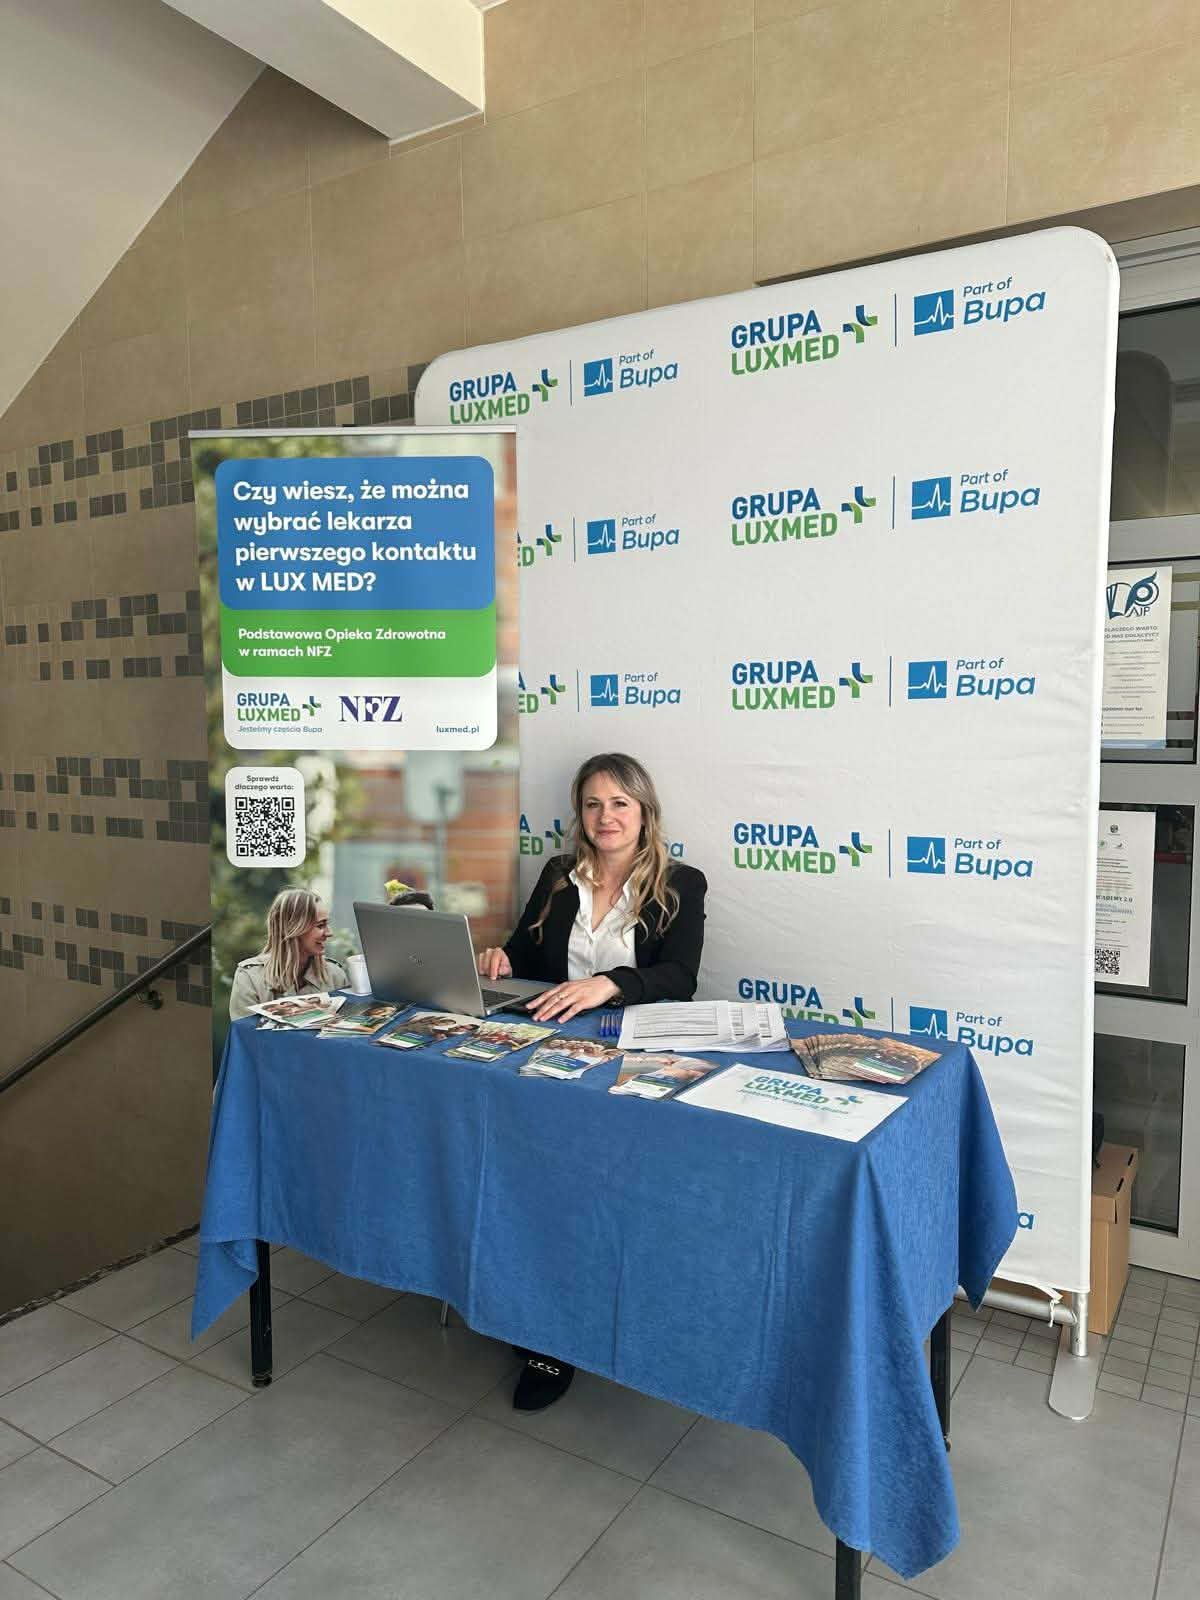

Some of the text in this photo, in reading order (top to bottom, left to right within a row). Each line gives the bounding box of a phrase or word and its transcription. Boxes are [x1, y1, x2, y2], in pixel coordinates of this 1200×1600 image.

[964, 277, 1012, 297] Part of
[964, 290, 1046, 325] Bupa
[731, 309, 822, 348] GRUPA
[619, 350, 654, 366] Part of
[732, 334, 840, 376] LUXMED
[450, 372, 517, 402] GRUPA
[620, 362, 678, 389] Bupa
[450, 393, 530, 424] LUXMED
[960, 469, 1008, 486] Part of
[233, 478, 468, 504] Czy wiesz, że można
[960, 487, 1040, 514] Bupa
[732, 487, 820, 520] GRUPA
[234, 511, 412, 536] wybrać lekarza
[622, 514, 656, 526] Part of
[732, 512, 838, 546] LUXMED
[622, 528, 680, 552] Bupa
[236, 542, 476, 566] pierwszego kontaktu
[236, 572, 376, 592] w LUX MED?
[238, 628, 446, 643] Podstawowa Opieka Zdrowotna
[239, 646, 332, 657] w ramach NFZ
[732, 659, 818, 685] GRUPA
[956, 658, 1004, 670] Part of
[624, 672, 658, 682] Part of
[956, 674, 1036, 700] Bupa
[237, 692, 290, 706] GRUPA
[338, 696, 403, 722] NFZ
[625, 686, 681, 708] Bupa
[732, 685, 836, 710] LUXMED
[237, 708, 300, 722] LUXMED
[303, 726, 322, 734] Bupa
[436, 726, 480, 734] luxmed.pl
[734, 822, 820, 848] GRUPA
[954, 838, 1002, 850] Part of
[734, 847, 836, 874] LUXMED
[954, 853, 1033, 880] Bupa
[738, 977, 823, 1010] GRUPA
[956, 1011, 1003, 1027] Part of
[957, 1026, 1034, 1056] Bupa
[744, 1082, 830, 1104] LUXMED
[754, 1076, 822, 1096] GRUPA
